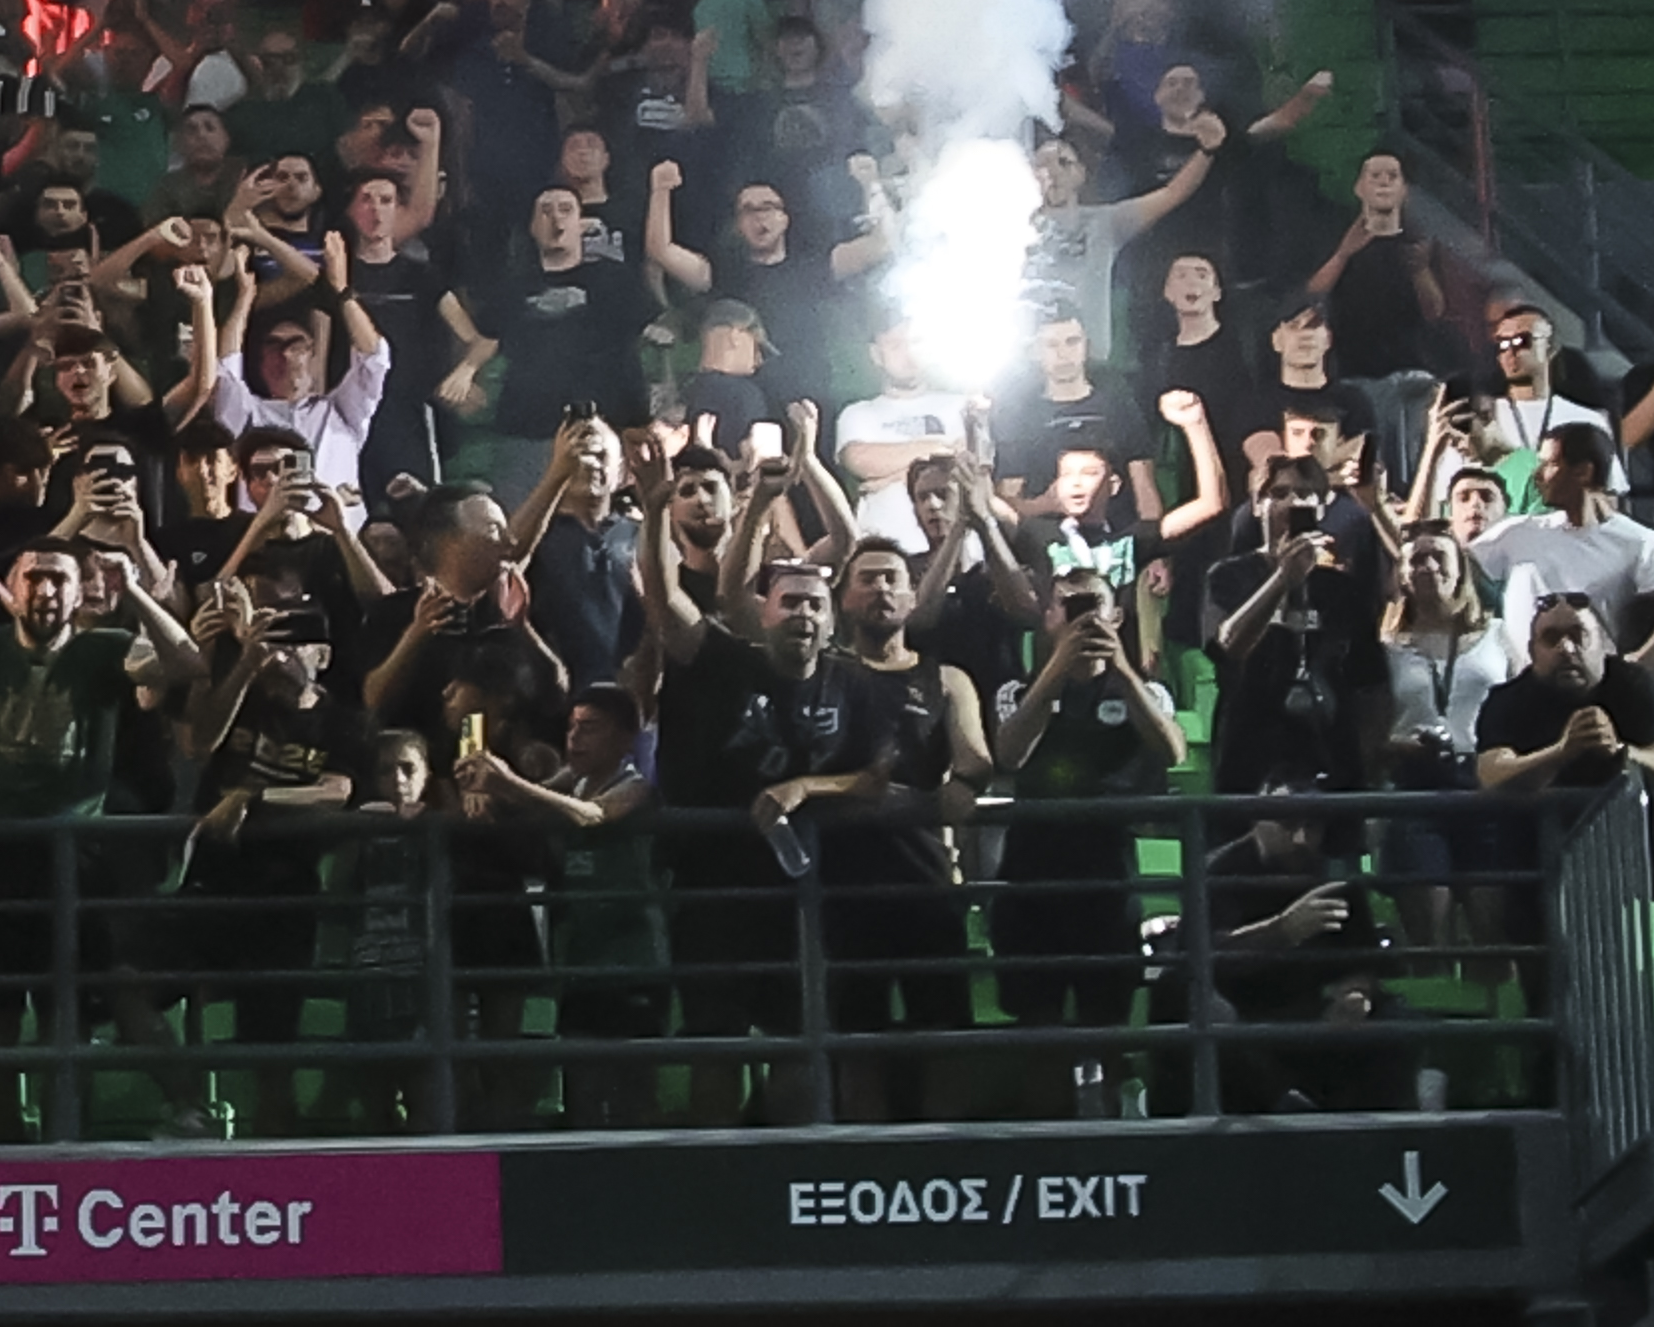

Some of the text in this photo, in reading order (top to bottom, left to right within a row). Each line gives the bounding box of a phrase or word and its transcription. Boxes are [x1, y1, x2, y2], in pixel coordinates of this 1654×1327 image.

[79, 1190, 311, 1247] Center
[790, 1175, 1147, 1224] ΕΞΟΔΟΣ / EXIT
